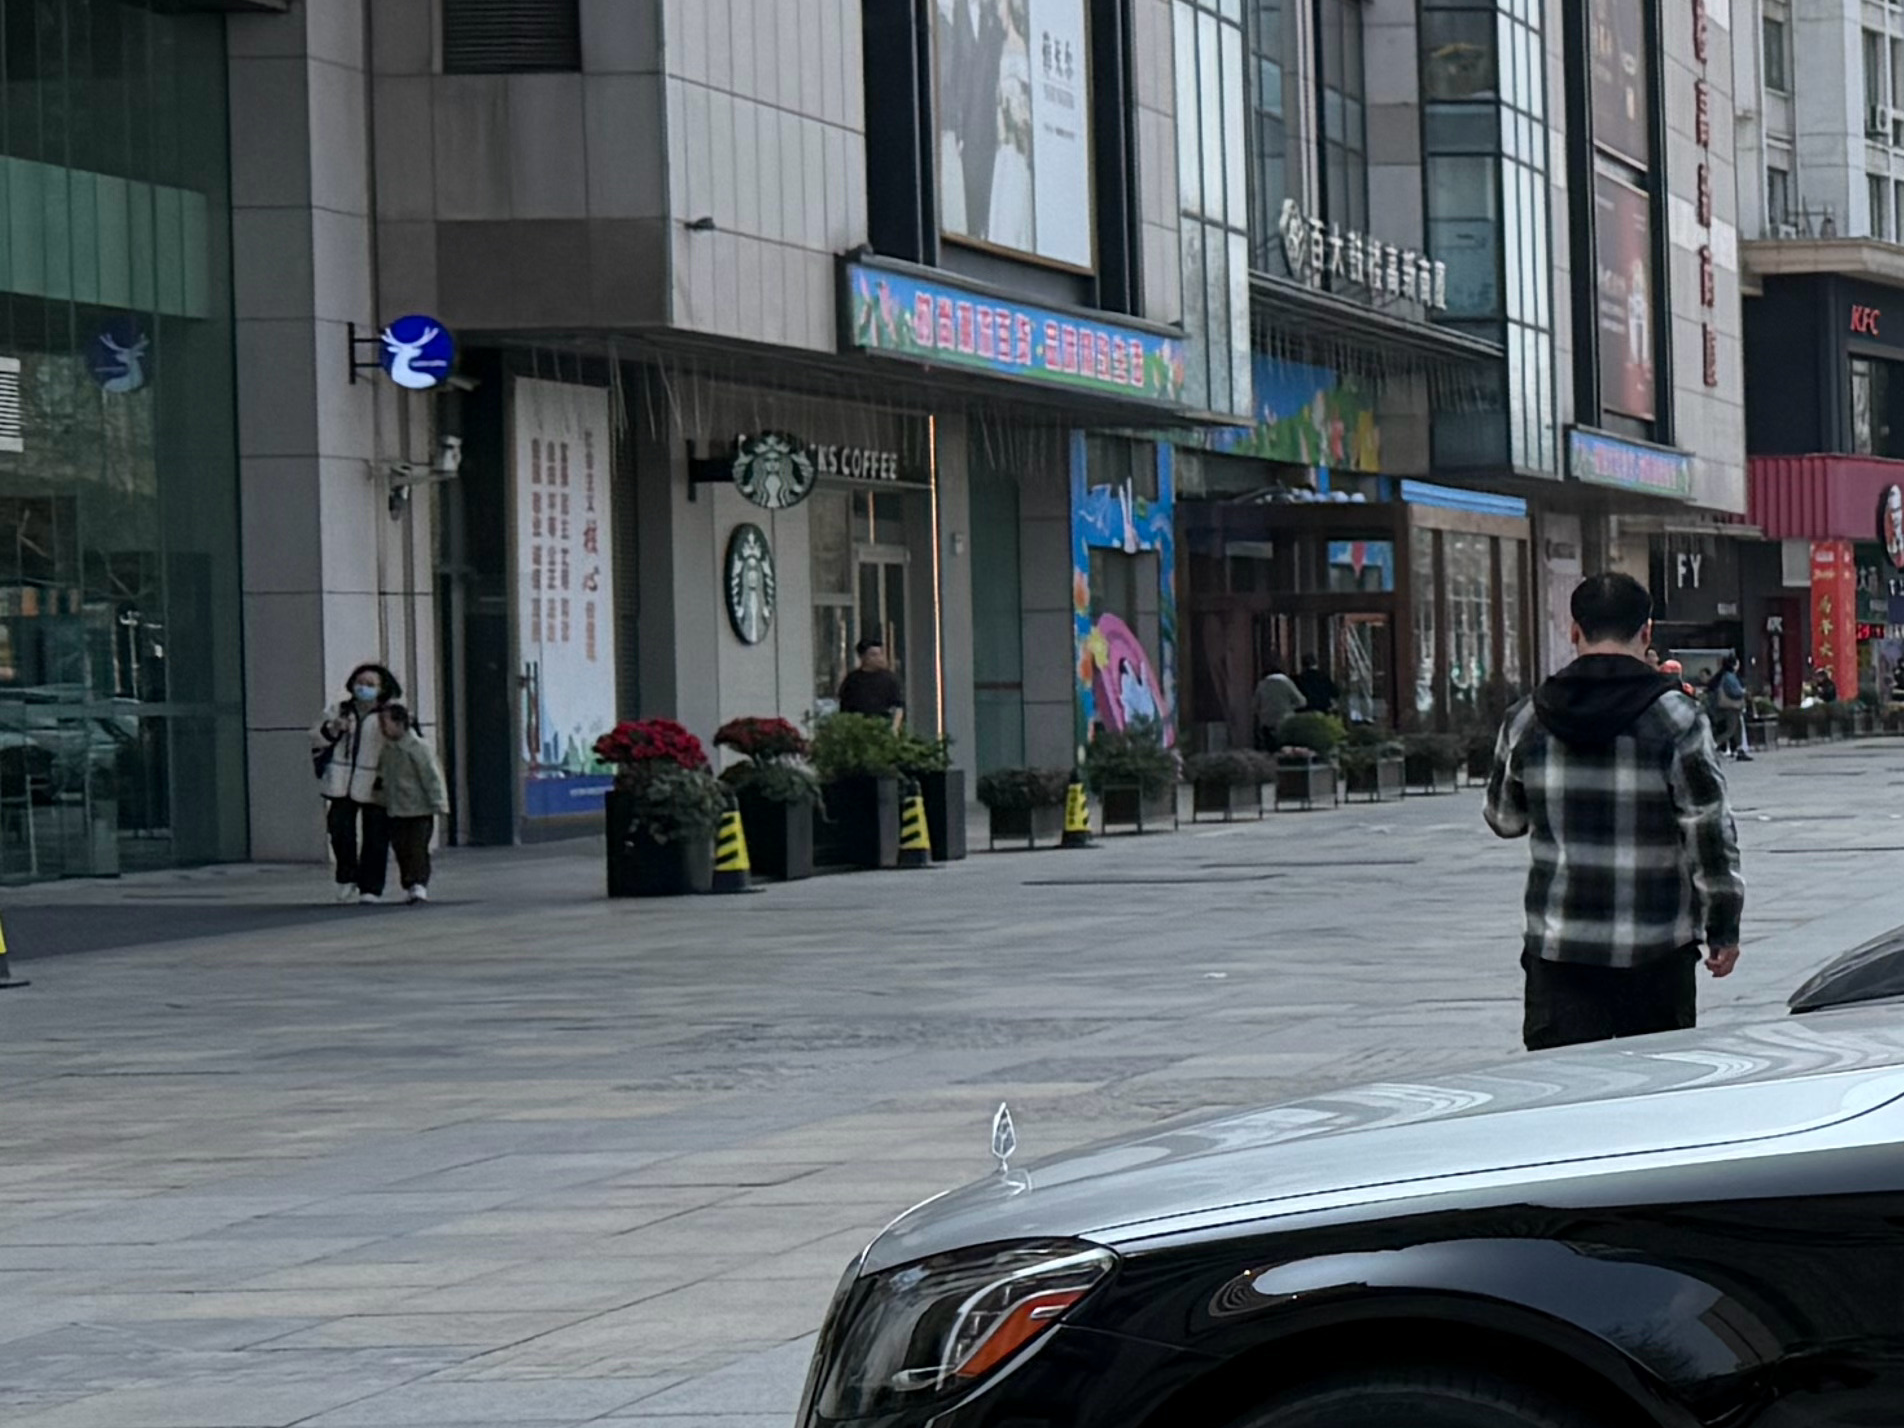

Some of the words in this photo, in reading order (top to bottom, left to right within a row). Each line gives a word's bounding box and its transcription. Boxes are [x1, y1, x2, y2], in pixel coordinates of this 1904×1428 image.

[1850, 303, 1881, 335] KFC
[841, 448, 899, 480] COFFEE
[1676, 552, 1701, 589] FY
